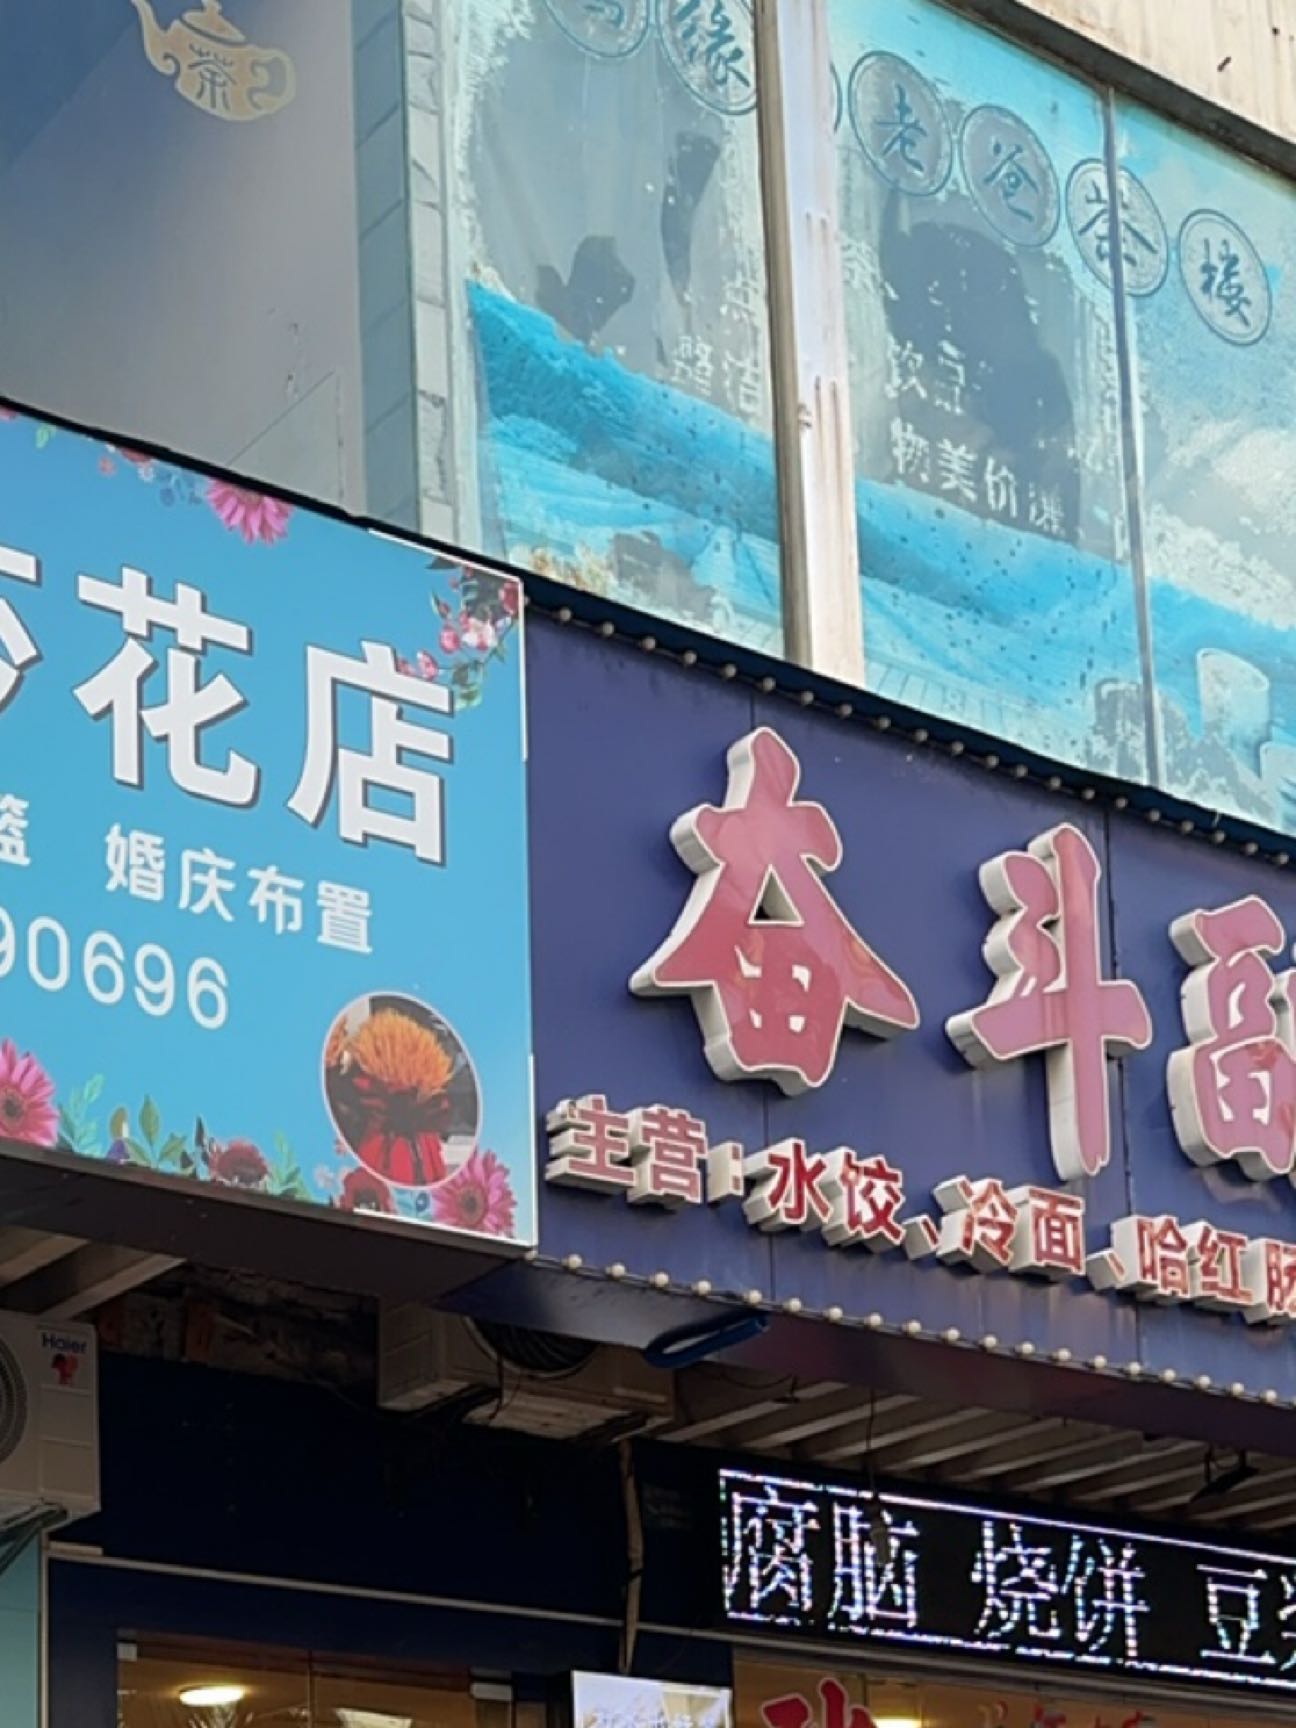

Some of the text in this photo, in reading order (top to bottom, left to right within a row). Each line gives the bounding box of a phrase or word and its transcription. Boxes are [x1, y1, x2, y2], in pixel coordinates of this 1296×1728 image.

[104, 823, 374, 955] 婚庆布置
[40, 1331, 87, 1354] Haier
[970, 1519, 1150, 1658] 烧饼
[1197, 1561, 1296, 1670] 豆
